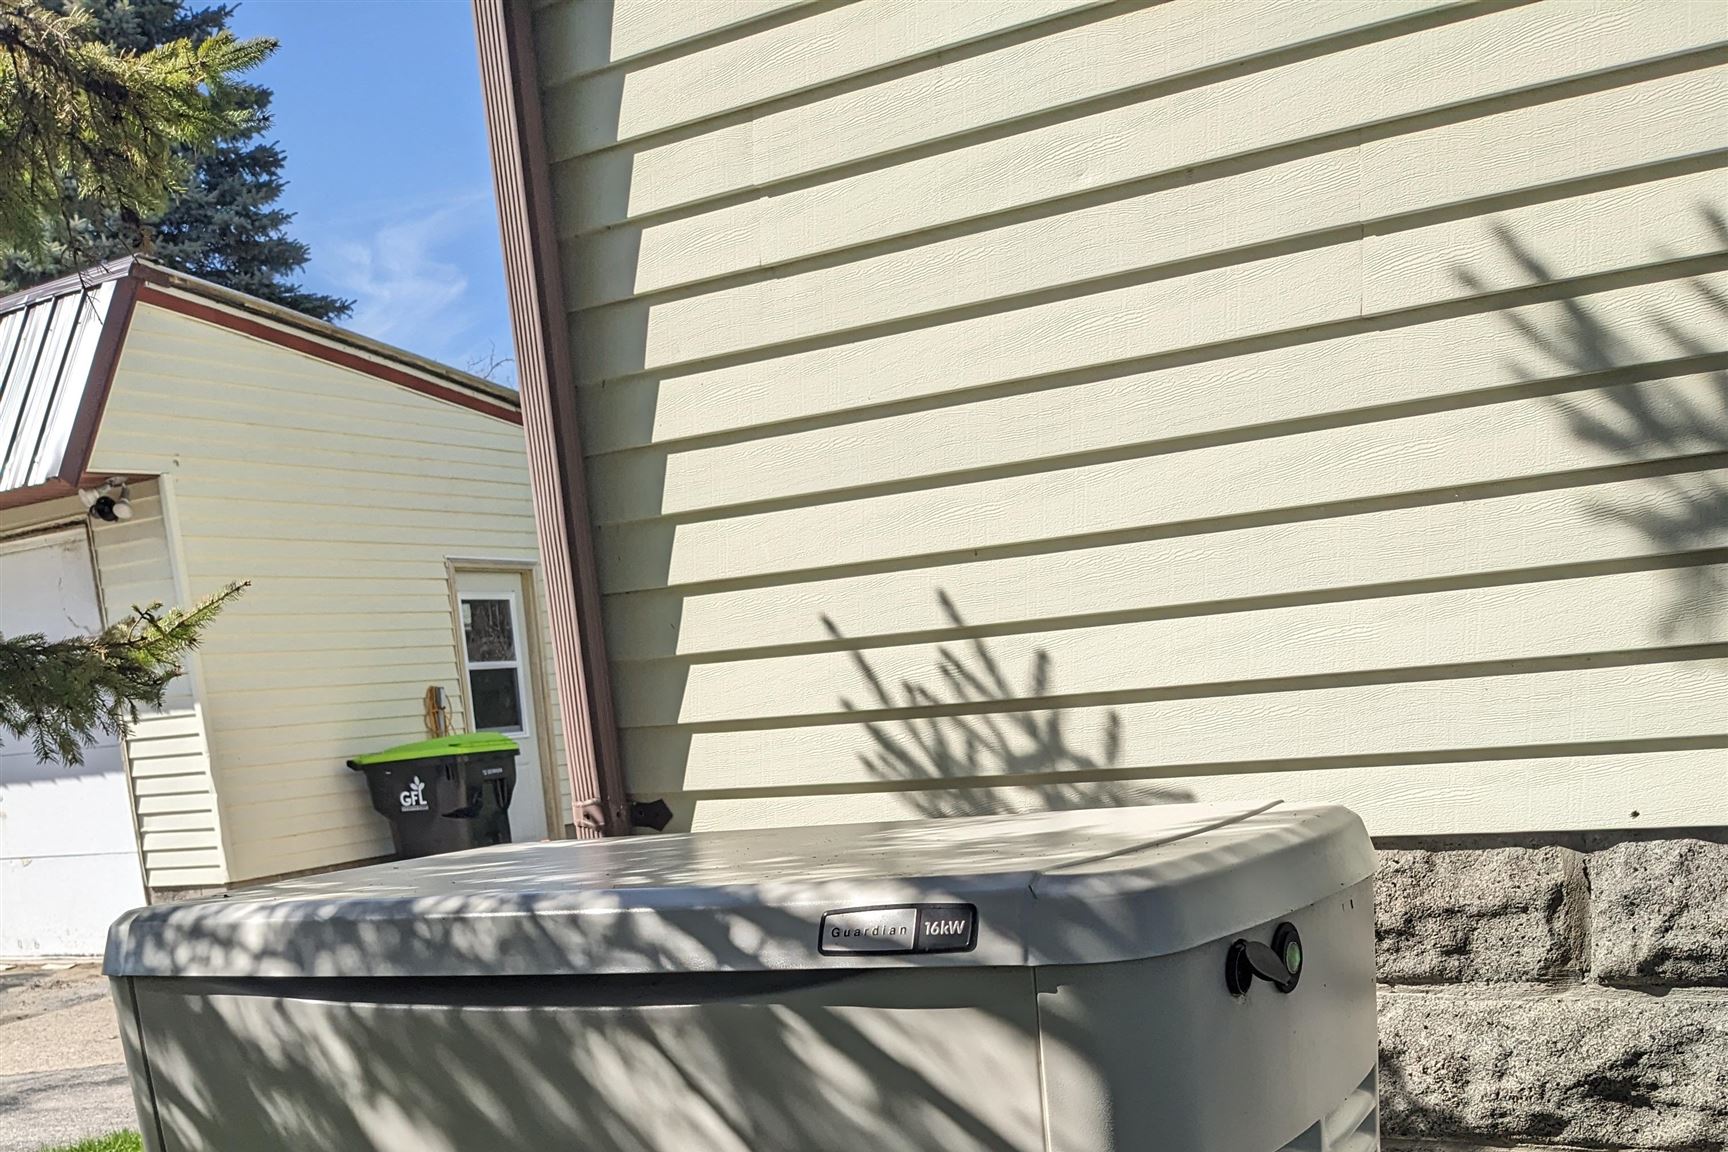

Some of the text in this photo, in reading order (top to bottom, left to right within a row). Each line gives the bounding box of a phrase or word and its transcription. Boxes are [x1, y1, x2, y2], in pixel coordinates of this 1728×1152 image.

[399, 786, 428, 807] GFL
[831, 920, 966, 938] Guardian 16kW
